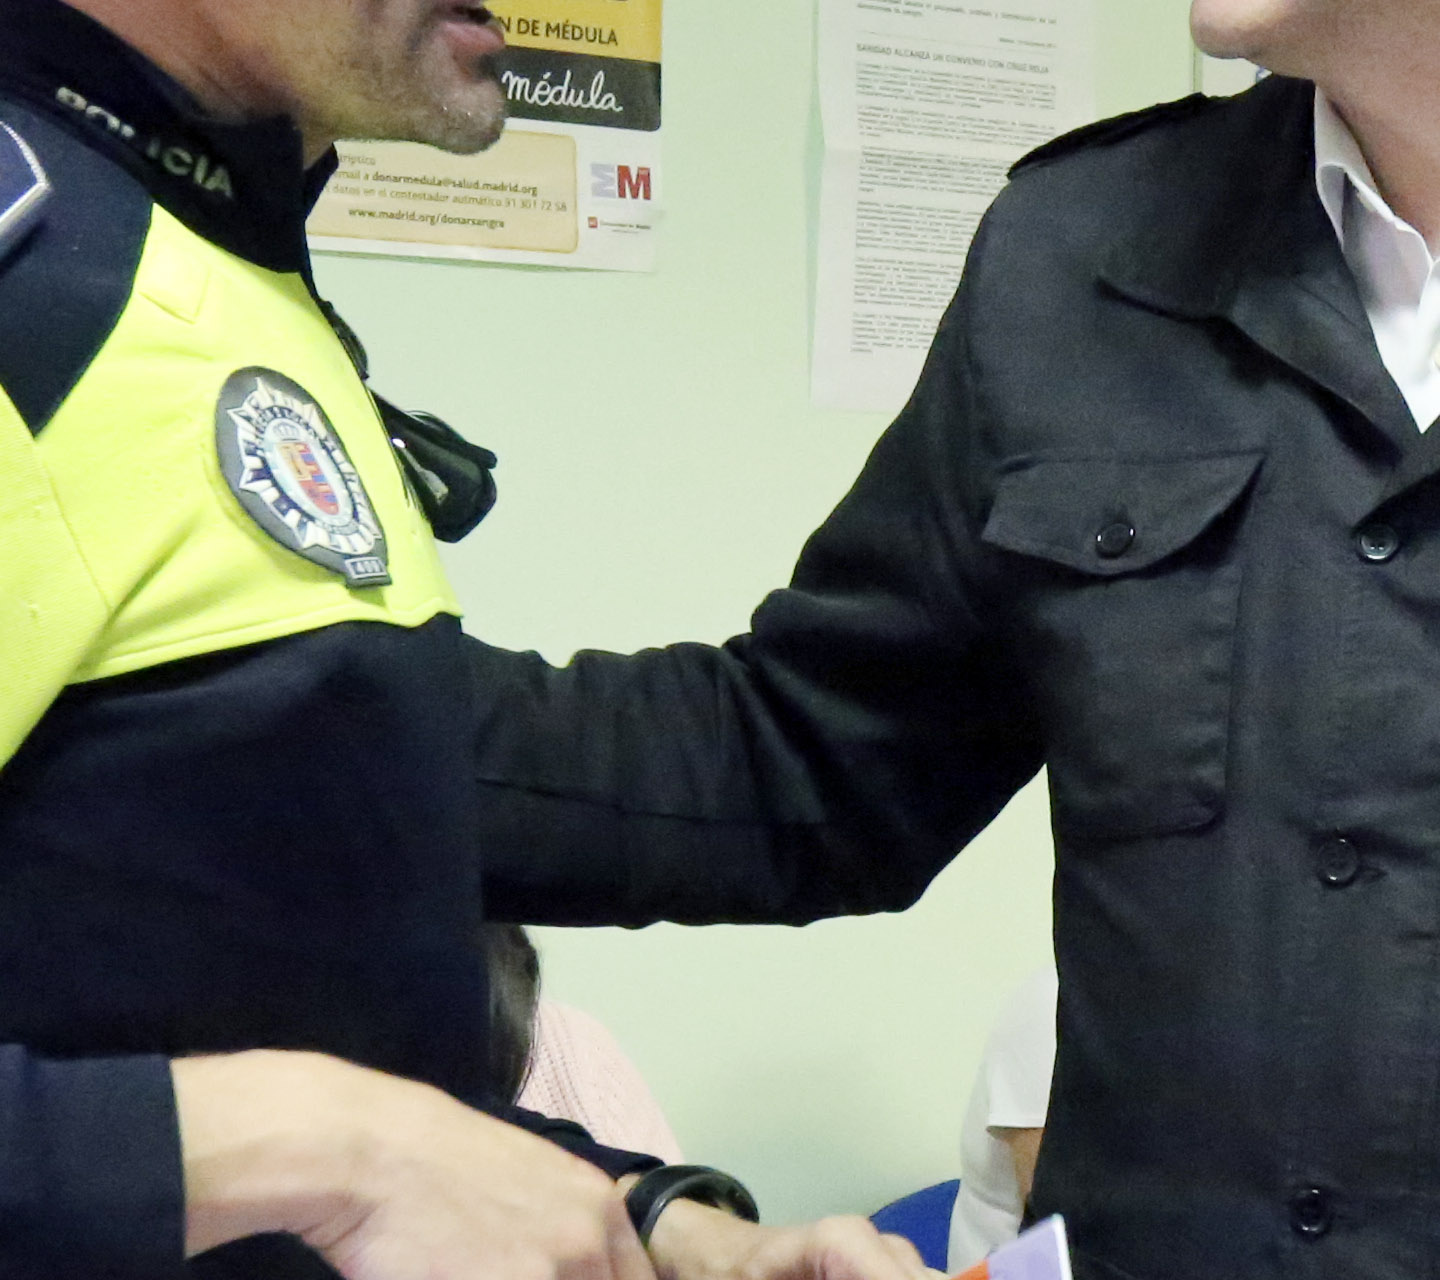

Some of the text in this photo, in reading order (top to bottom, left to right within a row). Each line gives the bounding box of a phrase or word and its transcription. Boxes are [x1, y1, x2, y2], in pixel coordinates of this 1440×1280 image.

[517, 18, 540, 36] DE
[545, 20, 618, 46] MÉDULA
[501, 70, 624, 112] médula
